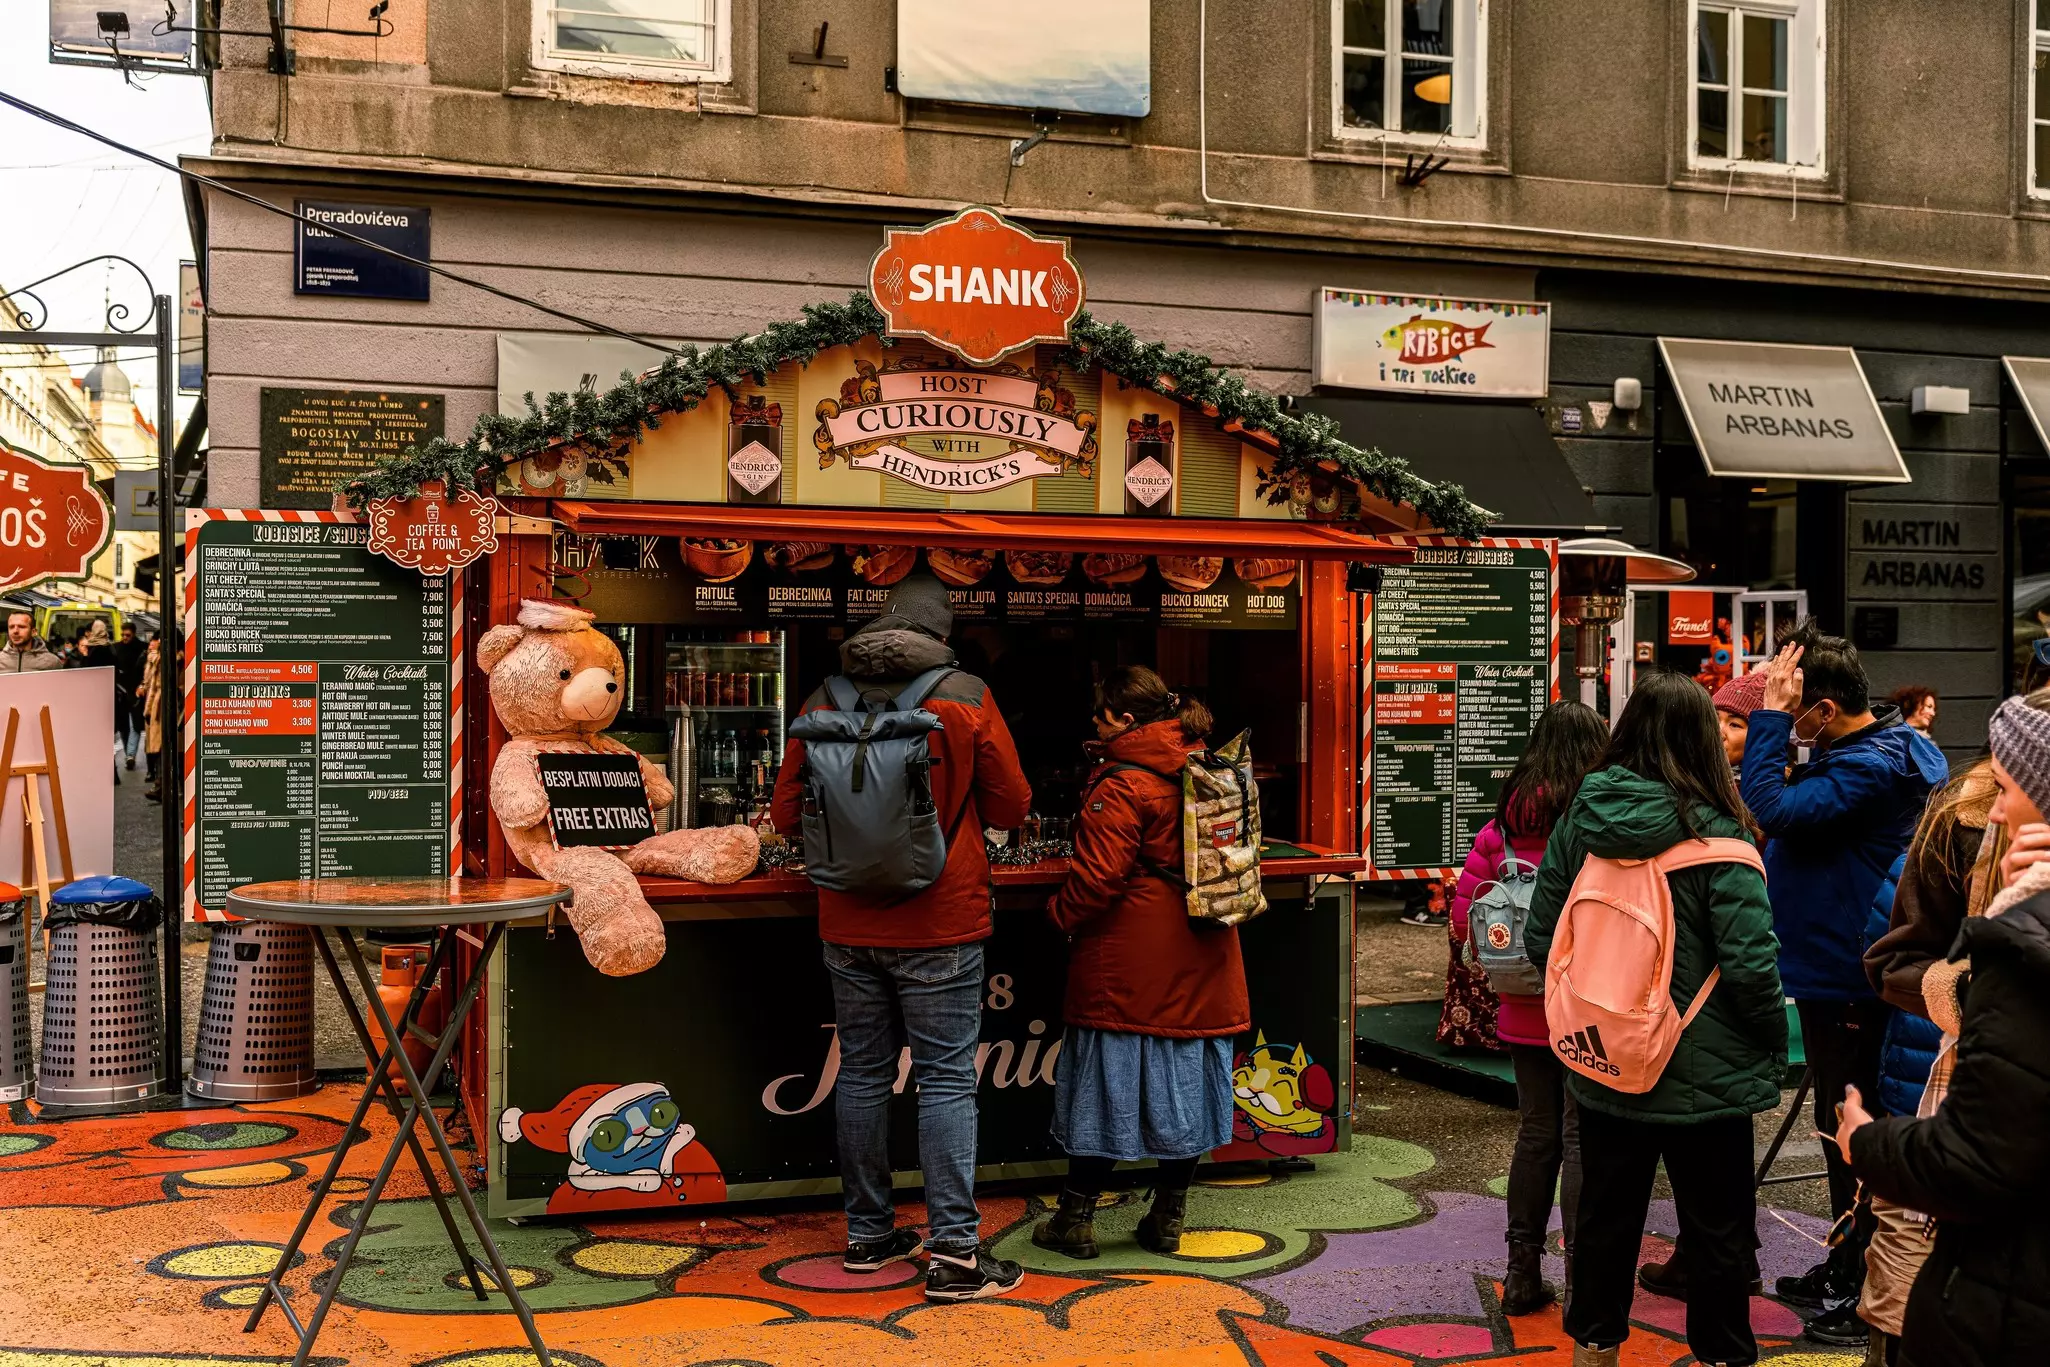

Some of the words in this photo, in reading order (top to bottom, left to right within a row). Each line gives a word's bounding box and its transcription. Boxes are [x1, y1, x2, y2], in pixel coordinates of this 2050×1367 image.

[307, 208, 408, 227] Preradovićeva
[909, 264, 1049, 308] SHANK
[920, 376, 987, 394] HOST
[1708, 382, 1814, 408] MARTIN
[856, 404, 1057, 441] CURIOUSLY
[1726, 414, 1854, 439] ARBANAS
[292, 428, 359, 439] BOGOSLAV
[375, 429, 415, 440] ŠULEK
[932, 439, 980, 453] WITH
[731, 462, 779, 472] HENDRICK'S
[881, 454, 1020, 487] HENDRICK'S
[1127, 476, 1170, 486] HENDRICK'S
[253, 525, 320, 544] KOBASICE
[408, 525, 447, 536] COFFEE
[451, 525, 458, 536] &
[1863, 519, 1960, 546] MARTIN
[405, 538, 425, 550] TEA
[432, 538, 462, 550] POINT
[205, 548, 251, 557] DEBRECINKA
[205, 561, 237, 571] GRINCHY
[238, 562, 260, 571] LJUTA
[595, 572, 639, 580] STREET
[1530, 571, 1545, 579] 4,50€
[1862, 560, 1984, 589] ARBANAS
[205, 575, 218, 584] FAT
[220, 576, 248, 585] CHEEZY
[422, 579, 443, 588] 6,00€
[1530, 582, 1545, 590] 5,50€
[205, 588, 235, 598] SANTA'S
[236, 589, 266, 598] SPECIAL
[422, 592, 443, 602] 7,90€
[696, 587, 735, 600] FRITULE
[769, 587, 832, 601] DEBRECINKA
[847, 590, 864, 602] FAT
[970, 591, 996, 604] LJUTA
[1007, 591, 1043, 604] SANTA'S
[1045, 592, 1080, 605] SPECIAL
[1085, 591, 1132, 606] DOMAĆICA
[1530, 593, 1545, 602] 6,00€
[1162, 594, 1191, 607] BUCKO
[1193, 594, 1229, 608] BUNCEK
[1248, 596, 1265, 608] HOT
[1267, 596, 1284, 608] DOG
[1400, 602, 1420, 611] SPECIAL
[1530, 604, 1545, 612] 7,90€
[205, 600, 243, 612] DOMAĆICA
[422, 606, 443, 615] 6,00€
[205, 616, 220, 625] HOT
[221, 616, 236, 625] DOG
[422, 619, 443, 628] 3,50€
[1530, 615, 1545, 624] 6,00€
[1671, 617, 1711, 633] Franck
[205, 630, 230, 639] BUCKO
[231, 630, 260, 639] BUNCEK
[422, 632, 443, 641] 7,50€
[1530, 626, 1545, 635] 3,50€
[1530, 637, 1545, 646] 7,50€
[205, 643, 237, 653] POMMES
[238, 643, 264, 653] FRITES
[422, 645, 443, 654] 3,50€
[1401, 648, 1419, 656] FRITES
[1530, 648, 1545, 657] 3,50€
[205, 664, 235, 674] FRITULE
[291, 665, 312, 674] 4,50€
[343, 665, 380, 680] Winter
[383, 665, 428, 680] Cocktails
[1378, 665, 1399, 674] FRITULE
[1438, 665, 1453, 674] 4,50€
[1474, 665, 1500, 679] Winter
[1502, 665, 1534, 679] Cocktails
[229, 685, 250, 698] HOT
[252, 685, 291, 698] DRINKS
[322, 682, 354, 691] TERANINO
[354, 682, 375, 690] MAGIC
[423, 682, 442, 691] 5,50€
[322, 692, 335, 700] HOT
[336, 692, 347, 700] GIN
[423, 692, 442, 700] 4,50€
[205, 700, 227, 708] BIJELO
[228, 700, 256, 708] KUHANO
[256, 700, 272, 708] VINO
[292, 700, 312, 708] 3,30€
[322, 702, 364, 710] STRAWBERRY
[365, 702, 378, 710] HOT
[379, 702, 390, 710] GIN
[423, 702, 442, 710] 5,00€
[205, 719, 223, 727] CRNO
[224, 719, 251, 727] KUHANO
[252, 719, 269, 727] VINO
[292, 717, 312, 726] 3,30€
[322, 712, 349, 721] ANTIQUE
[350, 712, 368, 720] MULE
[423, 711, 442, 720] 6,00€
[322, 722, 335, 730] HOT
[336, 722, 352, 730] JACK
[423, 721, 442, 730] 6,50€
[322, 732, 347, 740] WINTER
[347, 732, 365, 740] MULE
[423, 731, 442, 740] 6,00€
[322, 742, 366, 750] GINGERBREAD
[366, 741, 384, 750] MULE
[423, 741, 442, 749] 6,50€
[322, 752, 335, 760] HOT
[336, 751, 358, 760] RAKIJA
[423, 751, 442, 759] 6,00€
[322, 762, 344, 770] PUNCH
[422, 761, 442, 769] 6,00€
[322, 771, 344, 780] PUNCH
[344, 771, 376, 780] MOCKTAIL
[422, 770, 442, 779] 4,50€
[544, 771, 602, 788] BESPLATNI
[603, 771, 640, 788] DODACI
[554, 807, 593, 830] FREE
[593, 806, 650, 830] EXTRAS
[1557, 1039, 1621, 1077] adidas
